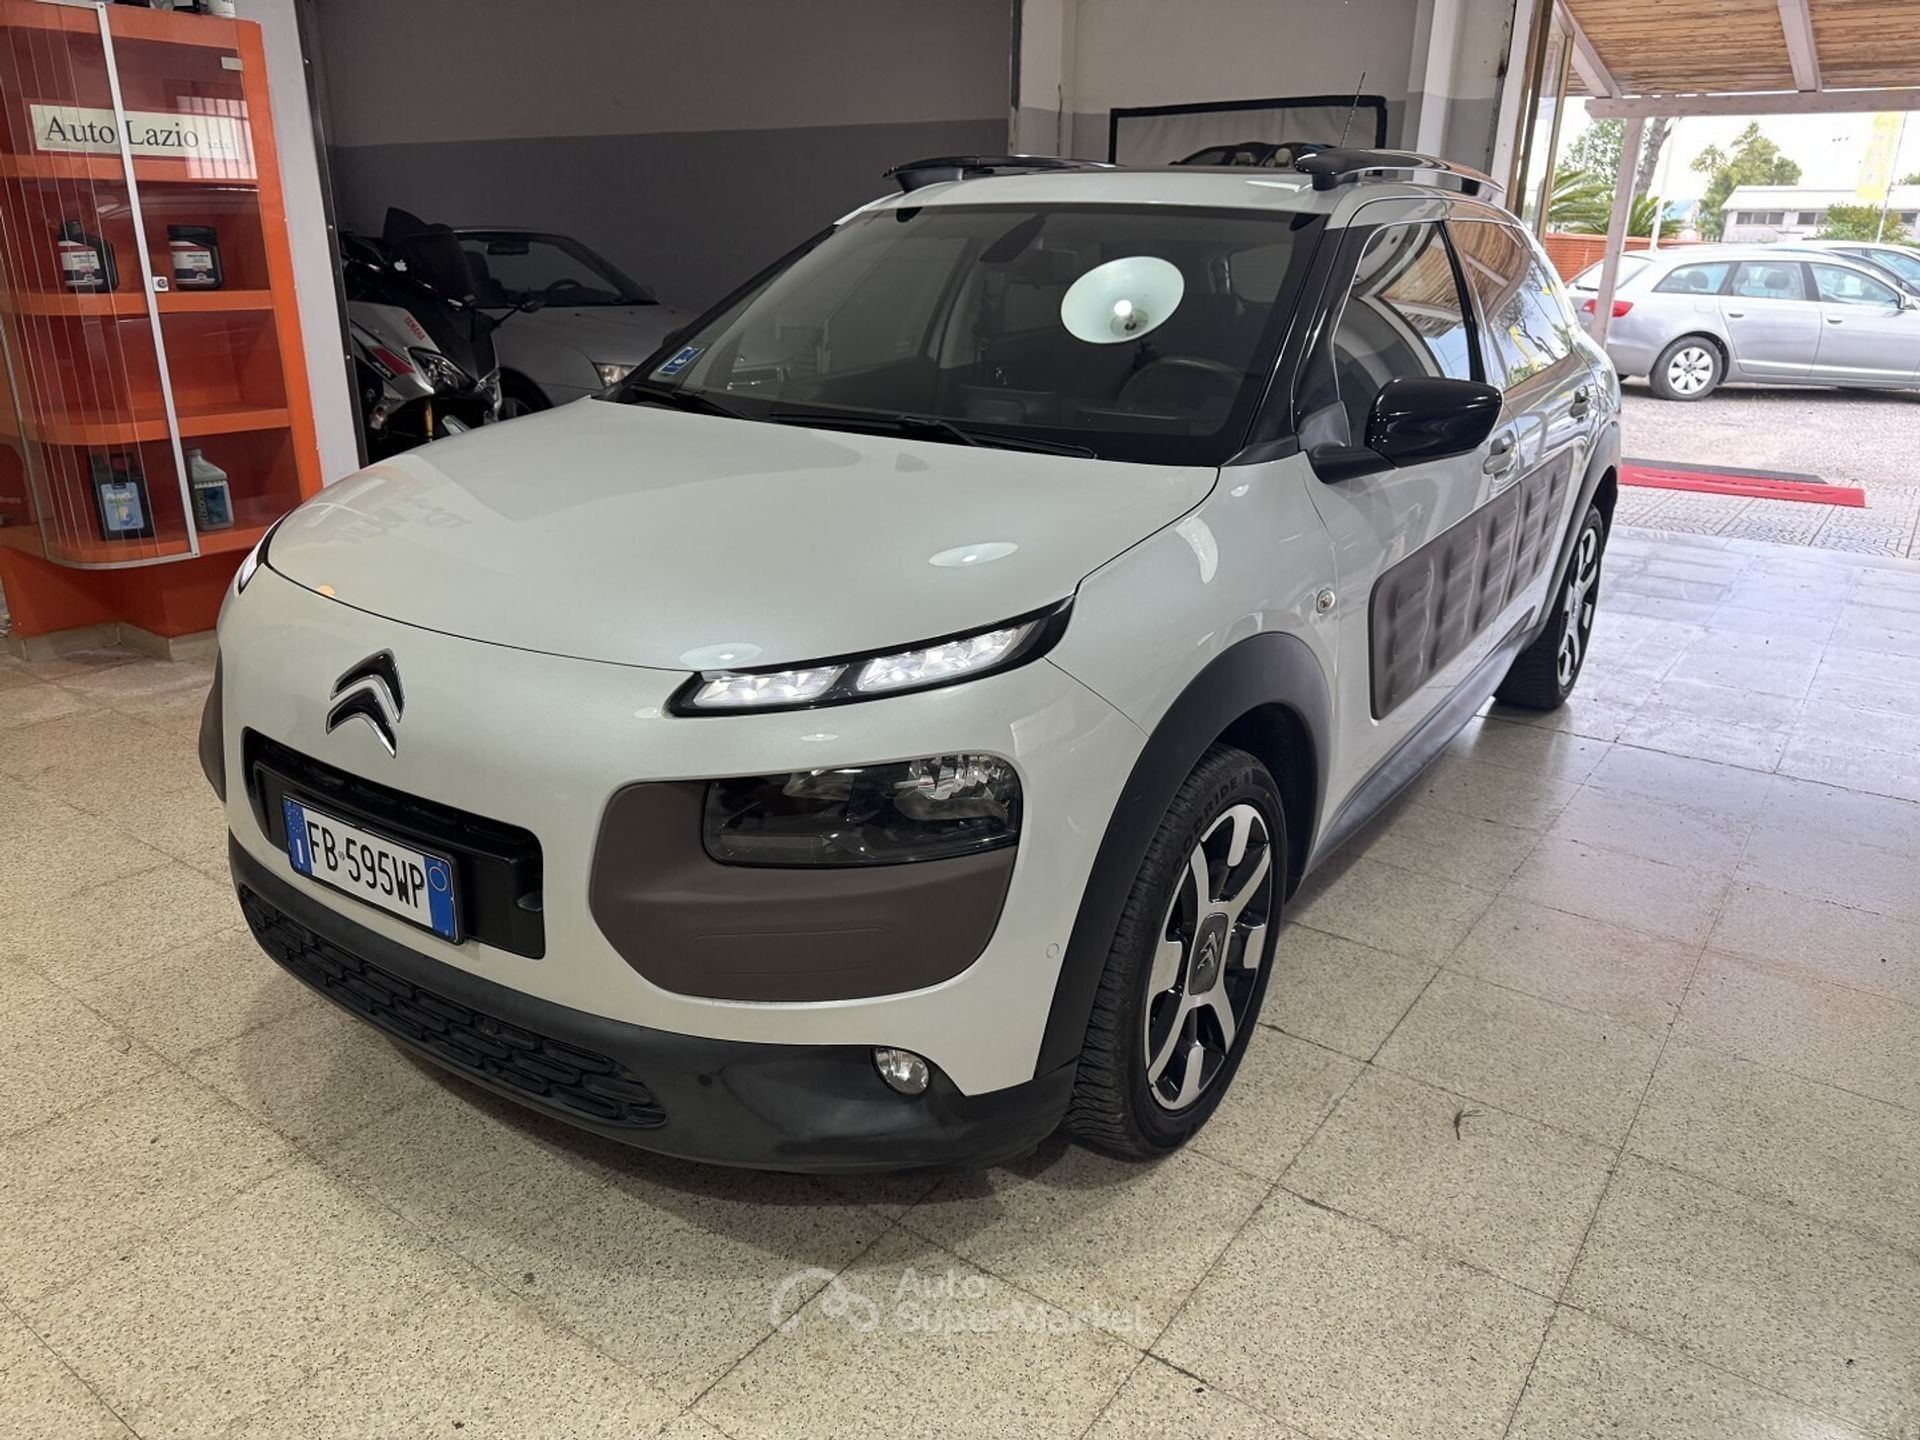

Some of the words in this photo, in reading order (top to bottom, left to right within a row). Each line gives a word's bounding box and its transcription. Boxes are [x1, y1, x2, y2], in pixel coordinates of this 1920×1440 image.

[45, 115, 115, 144] Auto
[125, 119, 199, 148] Lazio
[404, 315, 426, 341] YAMAHA
[306, 820, 338, 871] FB
[345, 837, 425, 908] 595WP
